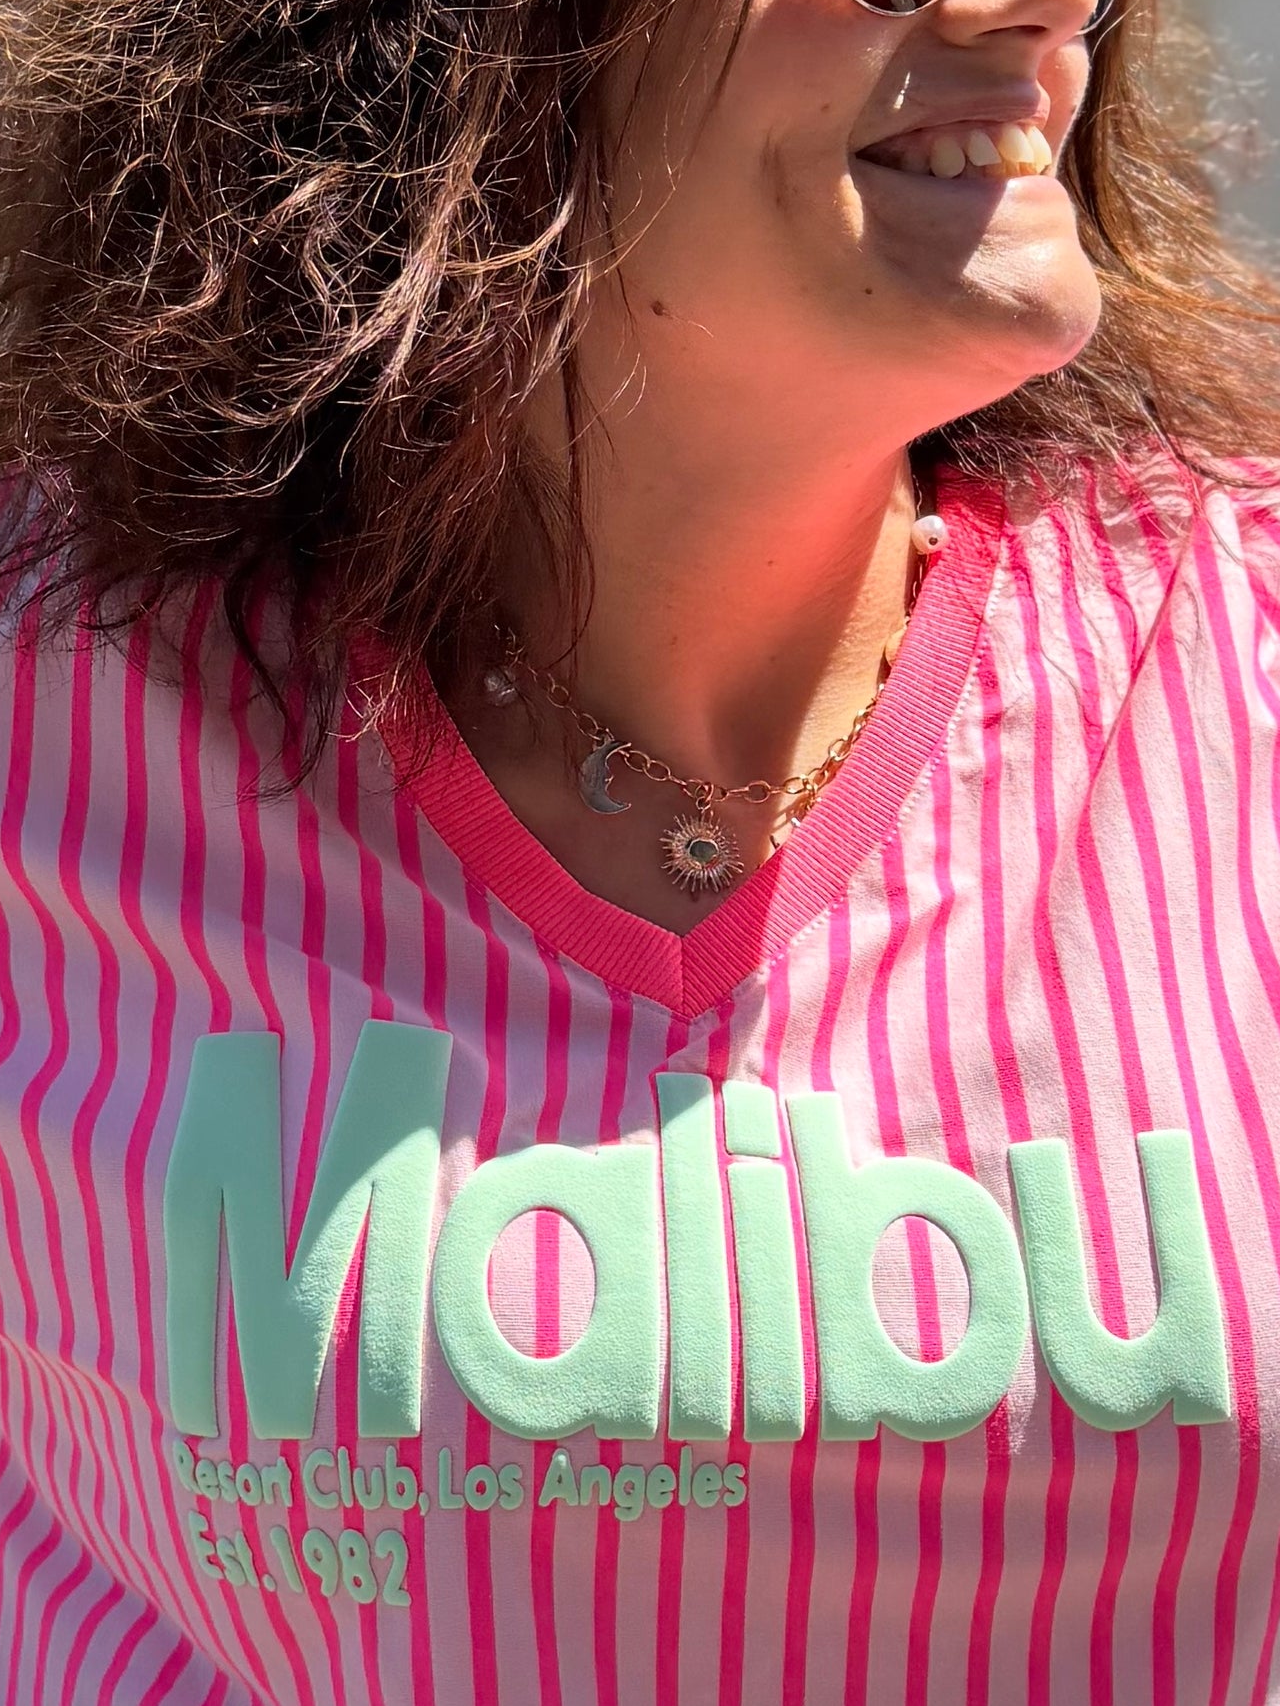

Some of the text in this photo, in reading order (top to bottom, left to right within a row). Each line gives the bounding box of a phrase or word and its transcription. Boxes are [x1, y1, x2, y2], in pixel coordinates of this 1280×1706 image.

[164, 1019, 1231, 1442] Malibu
[172, 1441, 748, 1521] Resort Club, Los Angeles
